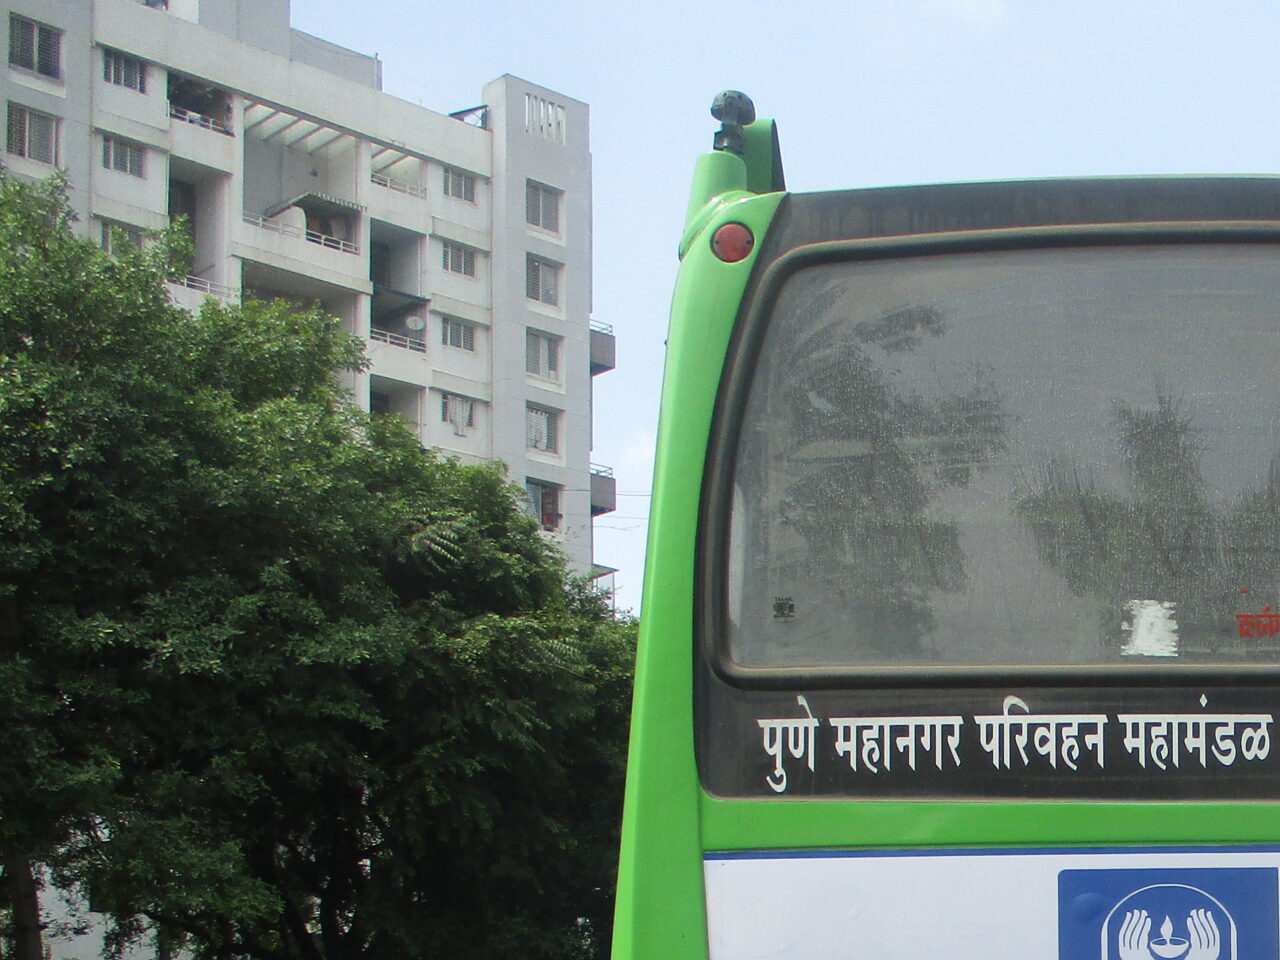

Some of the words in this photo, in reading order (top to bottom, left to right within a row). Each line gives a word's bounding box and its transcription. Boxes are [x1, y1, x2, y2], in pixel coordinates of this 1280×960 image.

[757, 695, 819, 793] पुणे
[830, 715, 963, 774] महानगर
[973, 695, 1108, 771] परिवहन
[1118, 694, 1274, 769] महामंडळ
